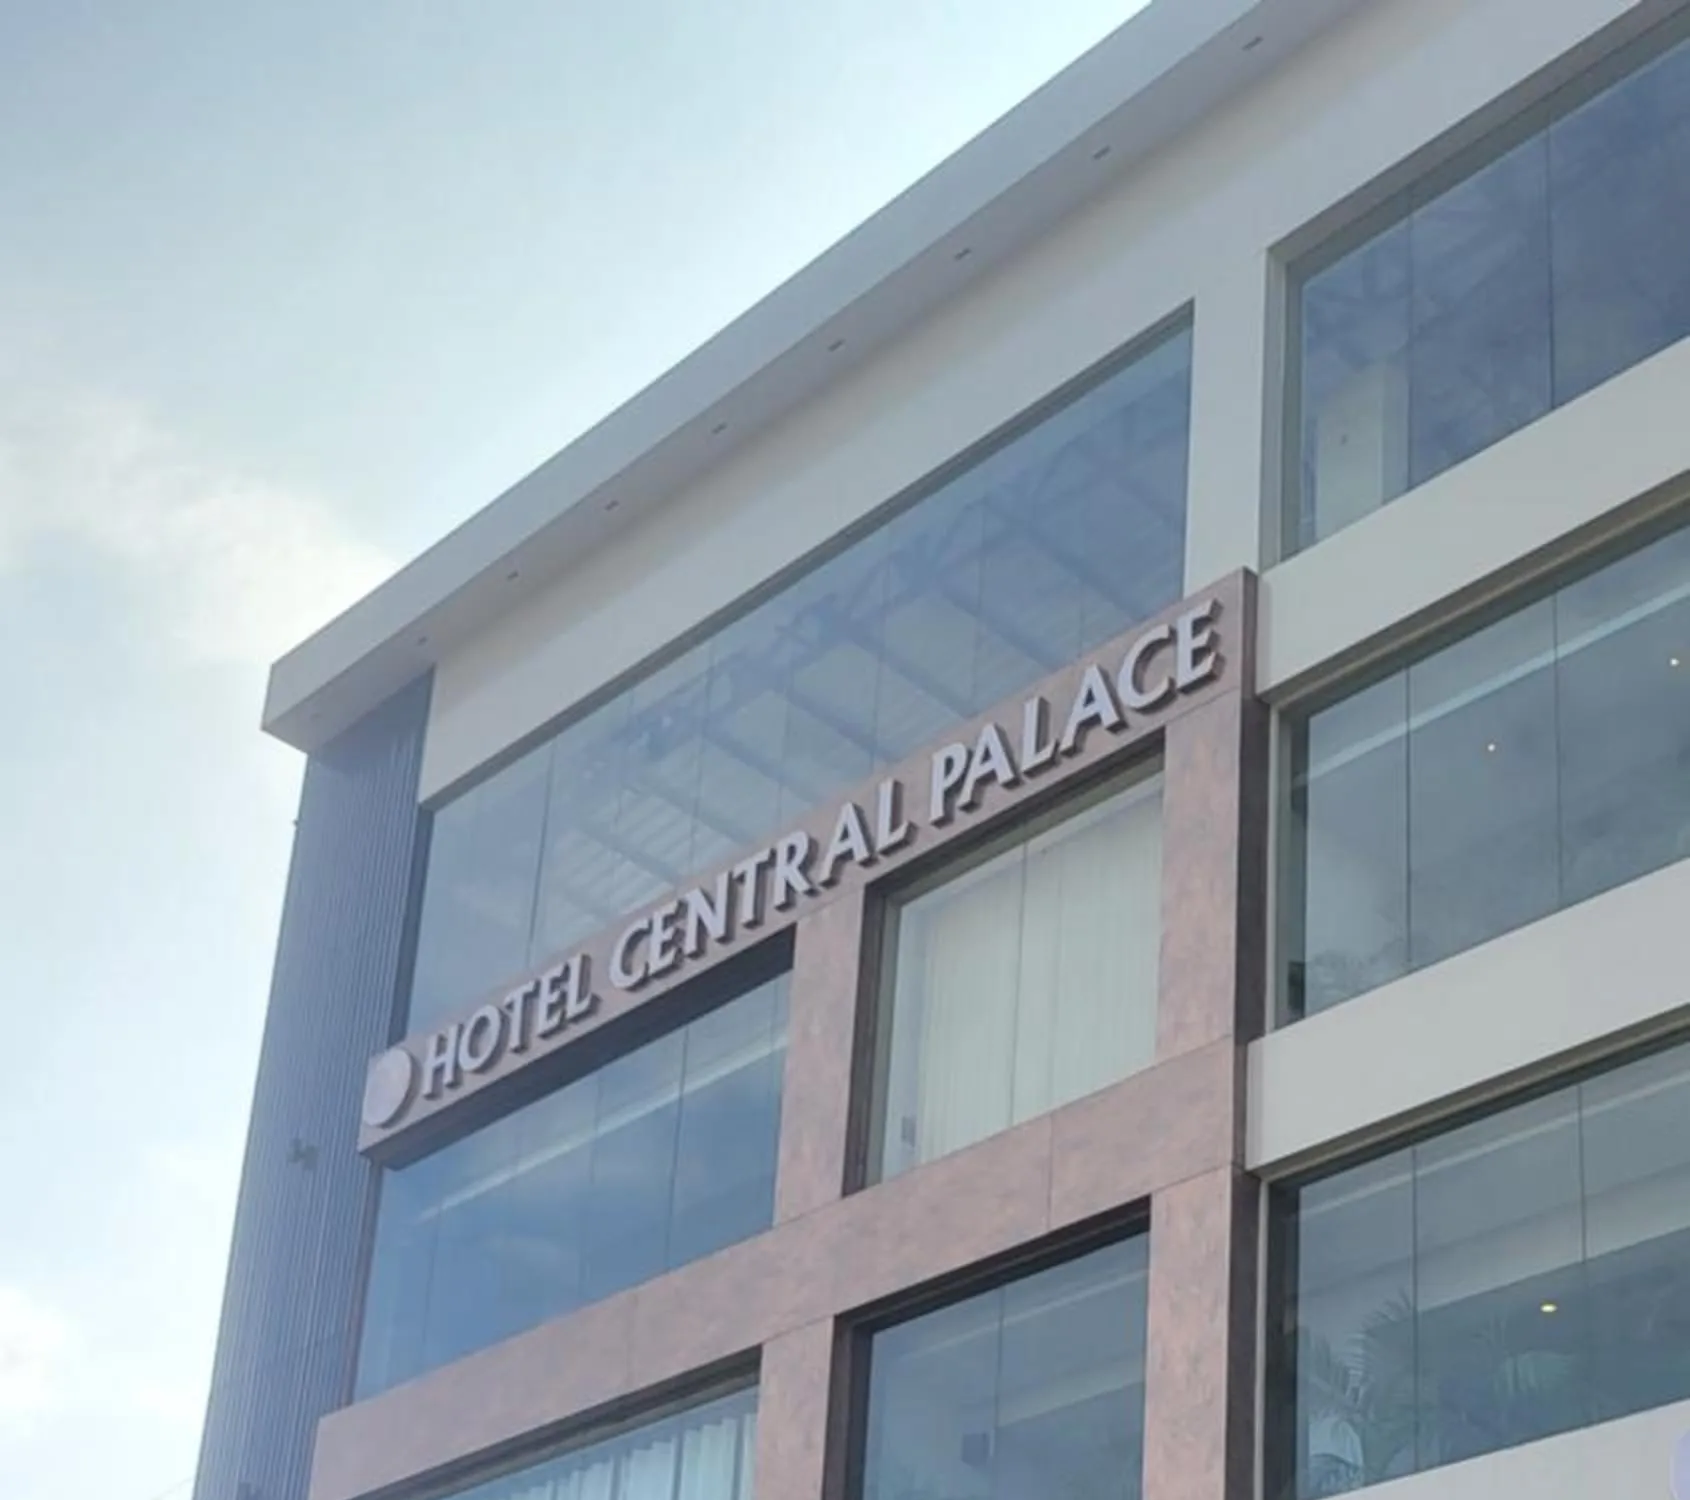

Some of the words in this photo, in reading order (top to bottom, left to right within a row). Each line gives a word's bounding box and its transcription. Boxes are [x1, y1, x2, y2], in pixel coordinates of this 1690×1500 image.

[420, 953, 600, 1100] HOTEL
[608, 778, 916, 994] CENTRAL
[928, 598, 1224, 826] PALACE
